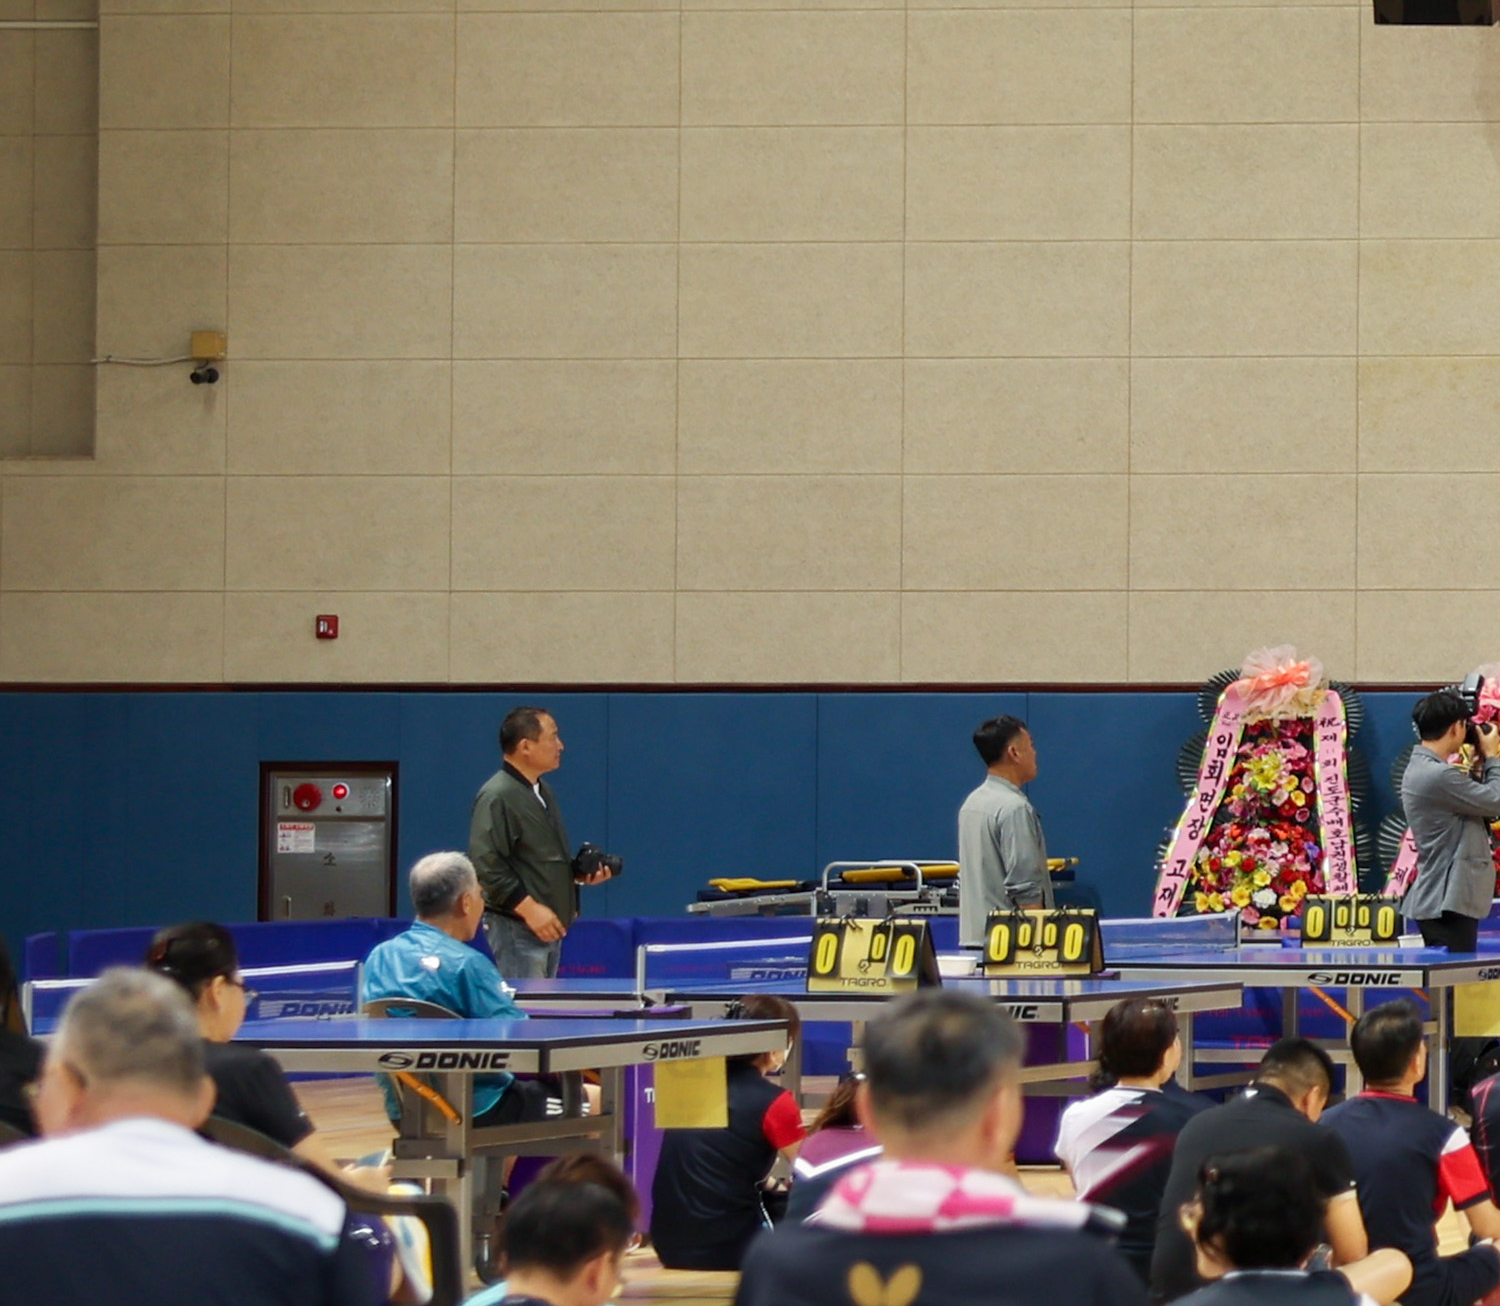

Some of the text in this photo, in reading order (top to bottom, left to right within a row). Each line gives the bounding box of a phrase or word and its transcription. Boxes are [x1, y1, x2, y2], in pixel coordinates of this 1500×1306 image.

[1015, 960, 1059, 970] TAGRO
[839, 977, 887, 988] TAGRO
[1334, 973, 1402, 985] DONIC
[658, 1040, 701, 1061] DONIC
[415, 1052, 510, 1070] DONIC
